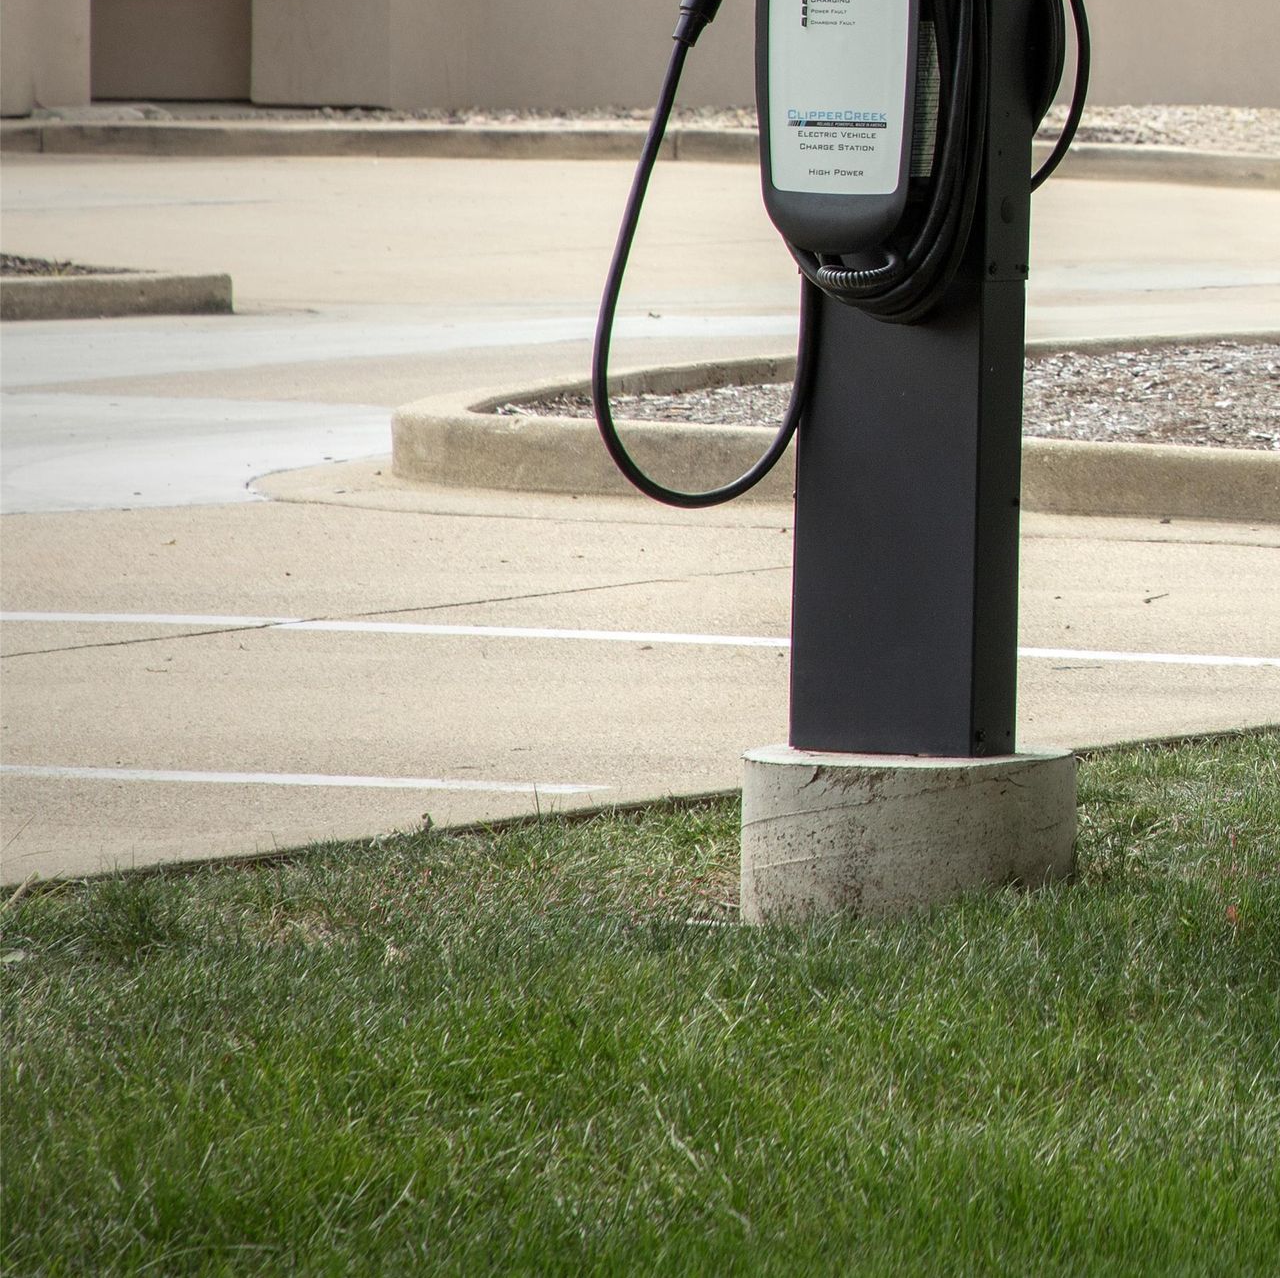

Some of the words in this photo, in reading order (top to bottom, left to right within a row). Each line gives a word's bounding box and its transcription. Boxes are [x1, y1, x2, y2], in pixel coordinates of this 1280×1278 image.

[787, 109, 887, 121] CLIPPERCREEK
[797, 130, 837, 138] ELECTRIC
[840, 131, 877, 139] VEHICLE
[799, 143, 834, 151] CHARGE
[838, 143, 875, 151] STATION
